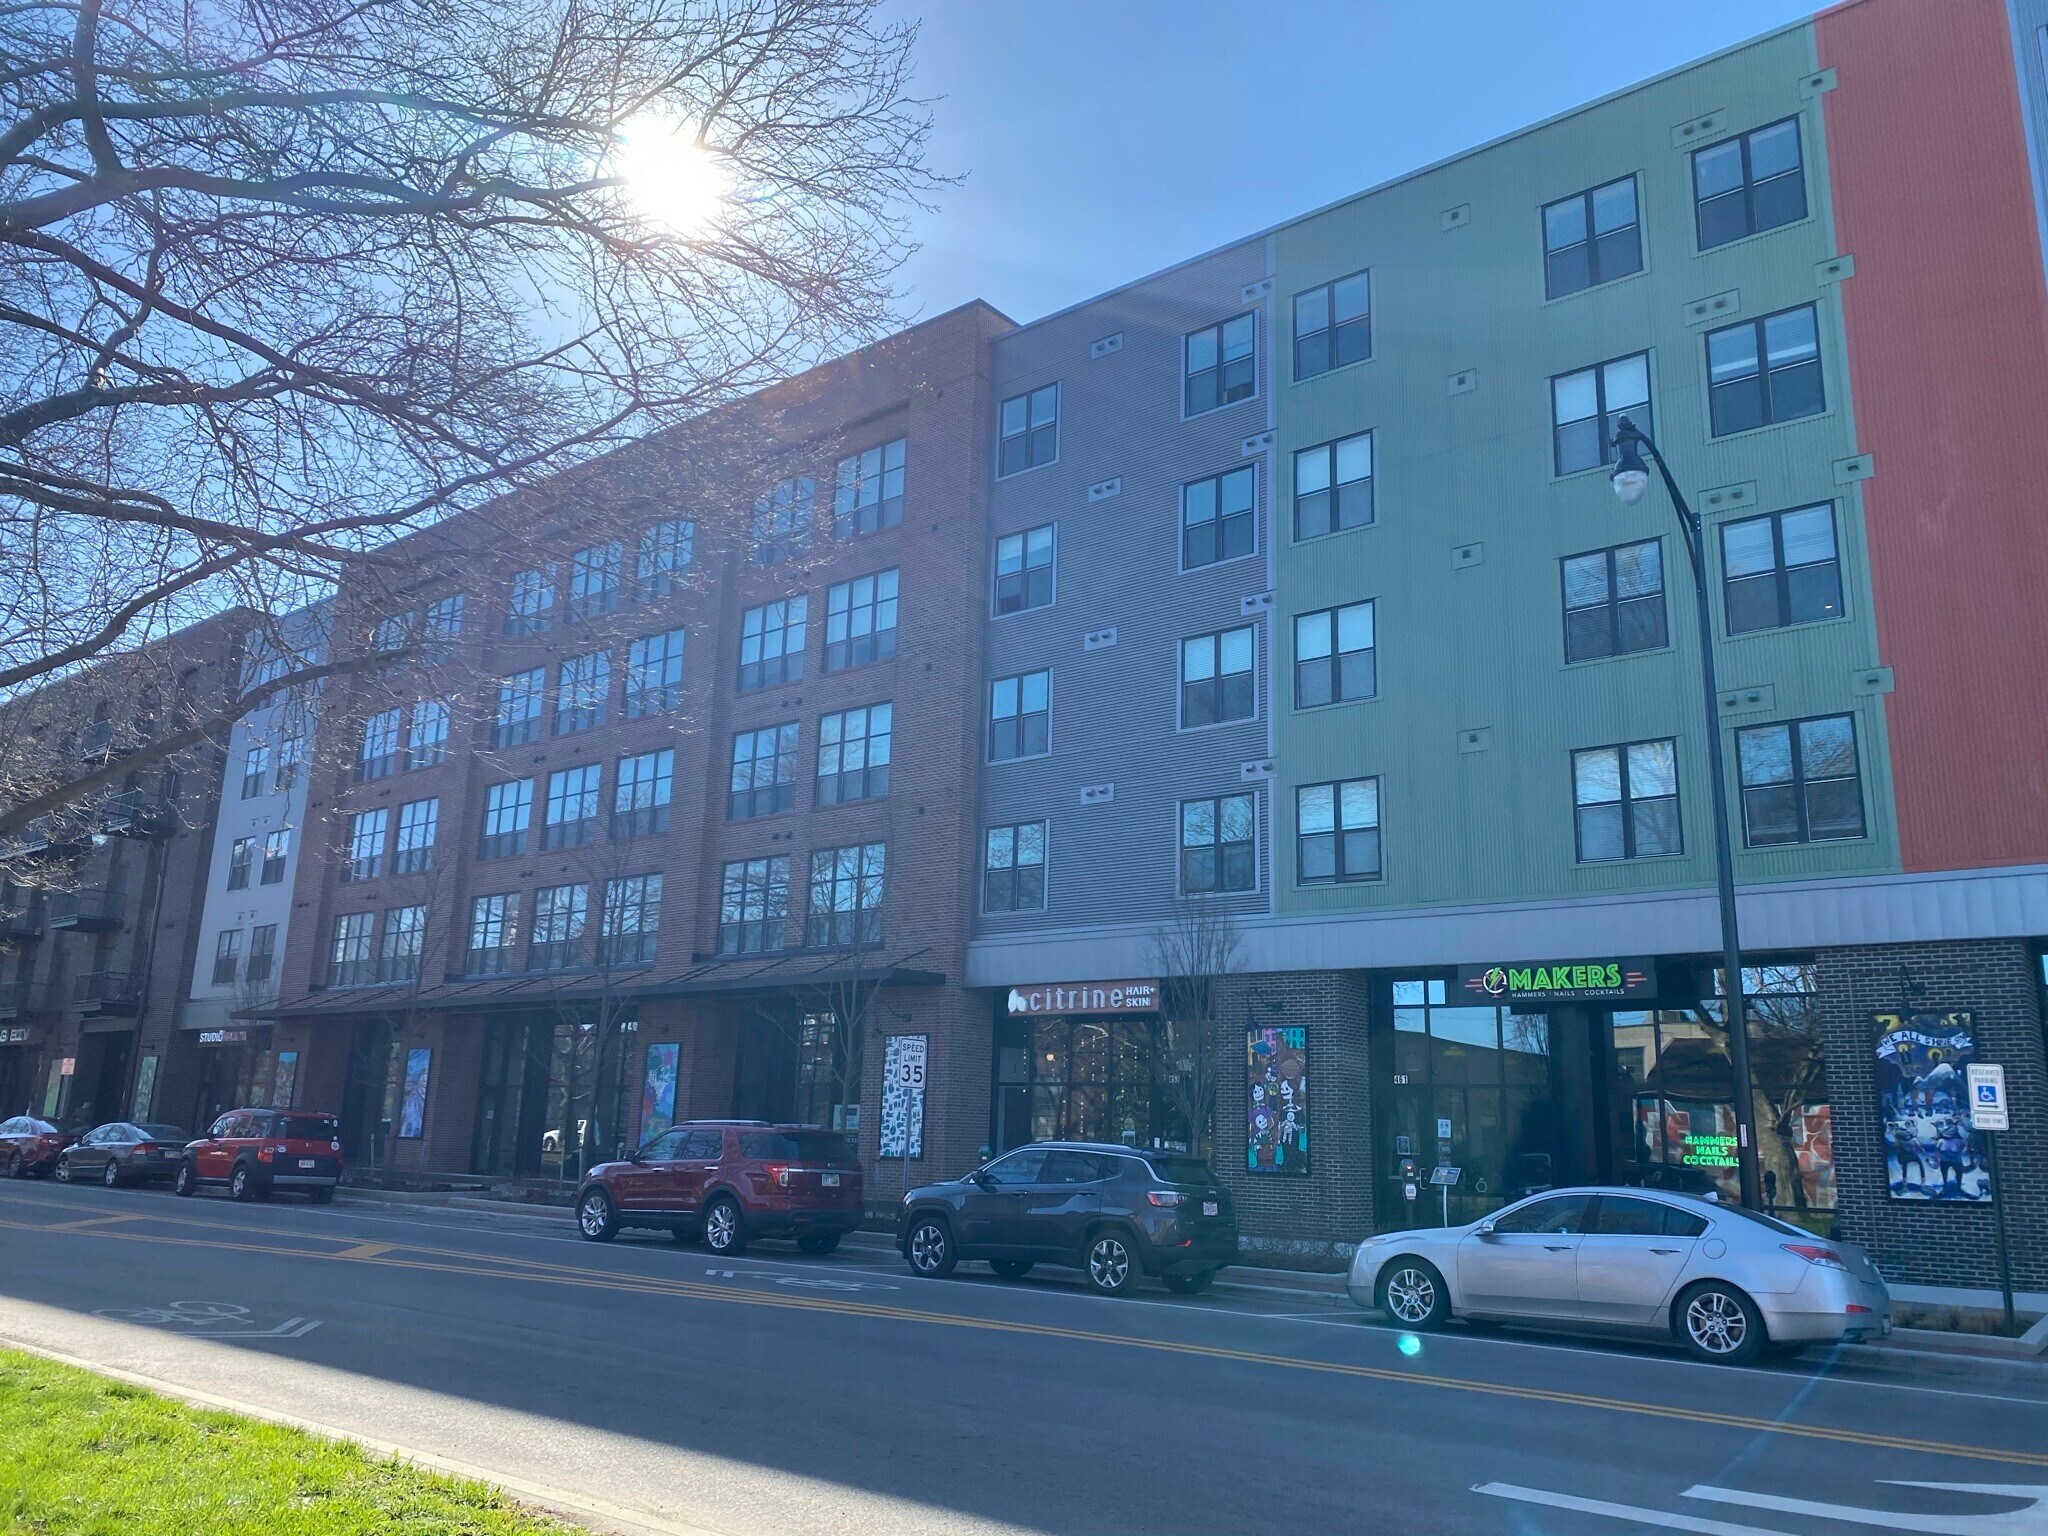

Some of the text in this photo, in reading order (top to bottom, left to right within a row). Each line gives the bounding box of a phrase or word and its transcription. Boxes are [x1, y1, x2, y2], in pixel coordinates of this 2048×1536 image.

[1508, 963, 1622, 991] MAKERS
[1584, 988, 1625, 996] COCKTAILS
[1029, 986, 1124, 1011] citrine
[1125, 997, 1151, 1008] SKIN
[199, 1029, 224, 1043] STUDIO
[1882, 1034, 1897, 1046] WE
[1901, 1031, 1921, 1042] ALL
[902, 1043, 924, 1053] SPEED
[904, 1054, 921, 1062] LIMIT
[901, 1064, 923, 1083] 35
[1684, 1135, 1738, 1147] HAMMERS
[1695, 1145, 1729, 1156] NAILS
[1683, 1155, 1740, 1167] COCKTAILS
